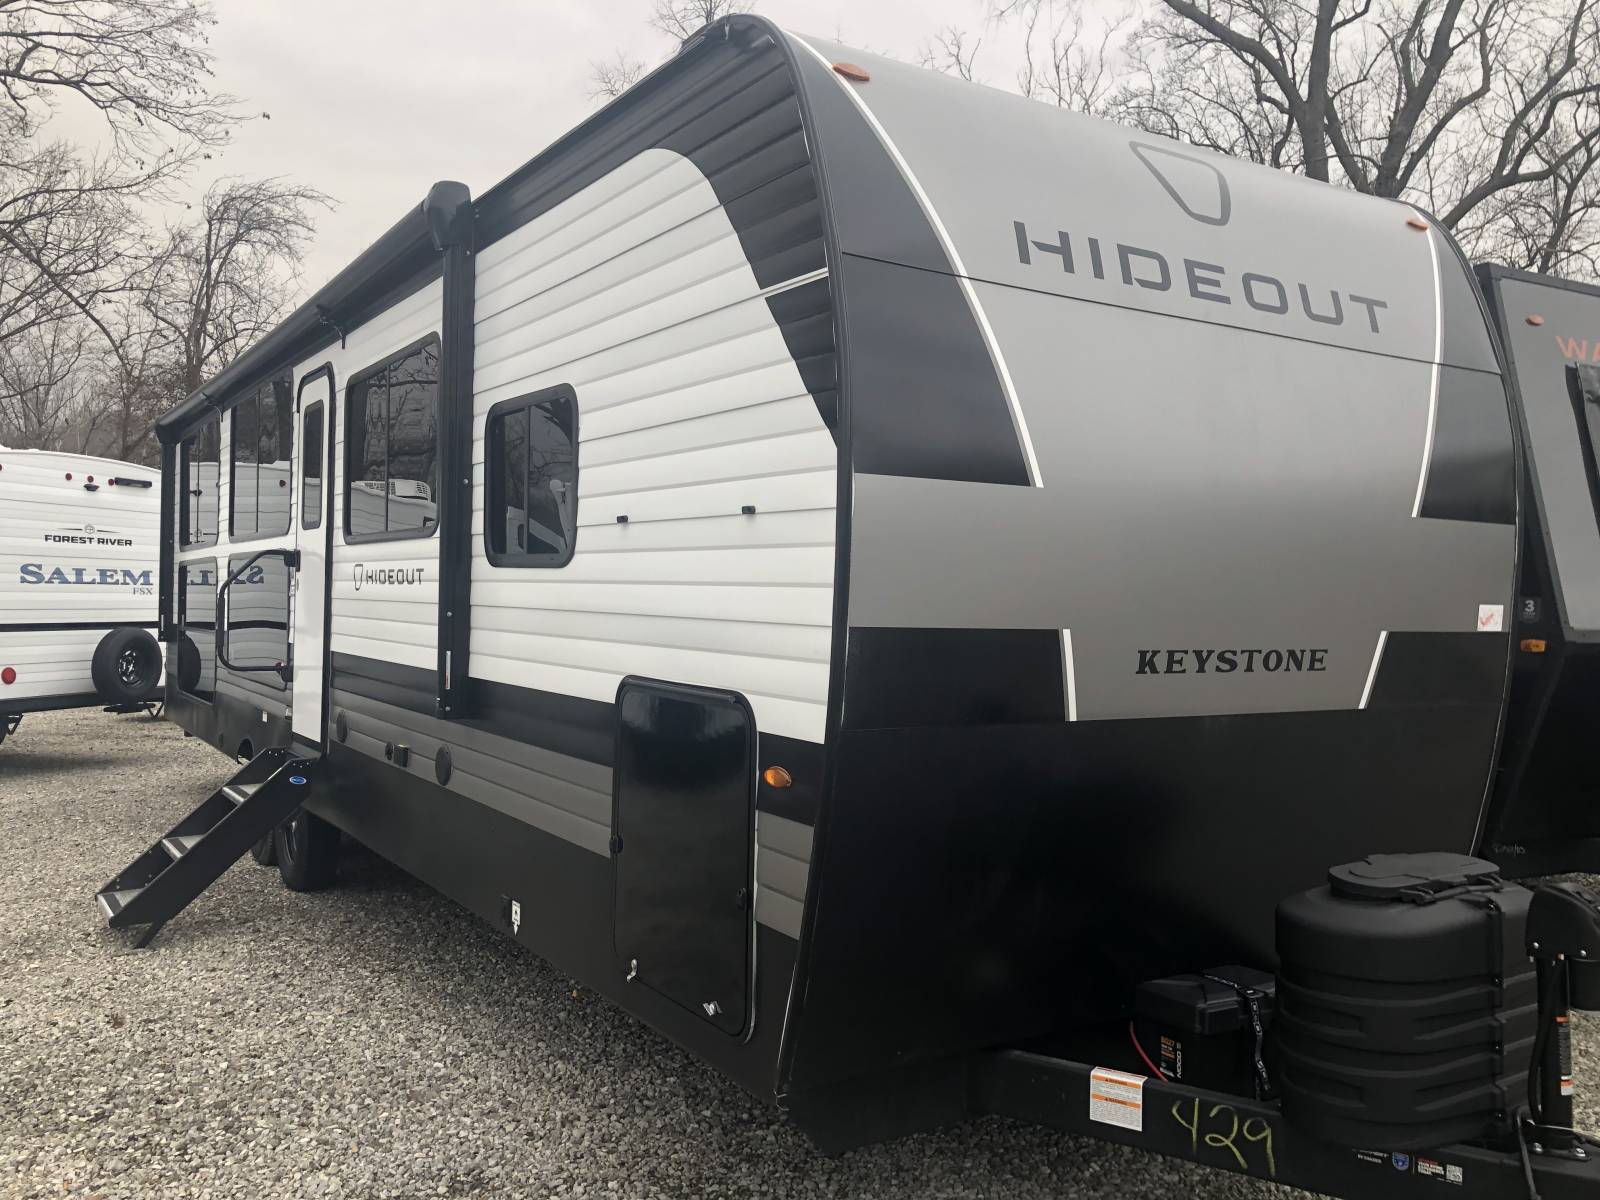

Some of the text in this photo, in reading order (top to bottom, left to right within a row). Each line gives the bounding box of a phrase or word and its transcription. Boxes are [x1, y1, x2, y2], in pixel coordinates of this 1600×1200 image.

[1013, 220, 1388, 334] HIDEOUT
[44, 534, 132, 547] FOREST RIVER
[19, 563, 153, 586] SALEM
[365, 568, 425, 585] HIDEOUT
[132, 587, 153, 596] FSX
[1135, 648, 1329, 675] KEYSTONE
[1171, 1096, 1276, 1177] 429
